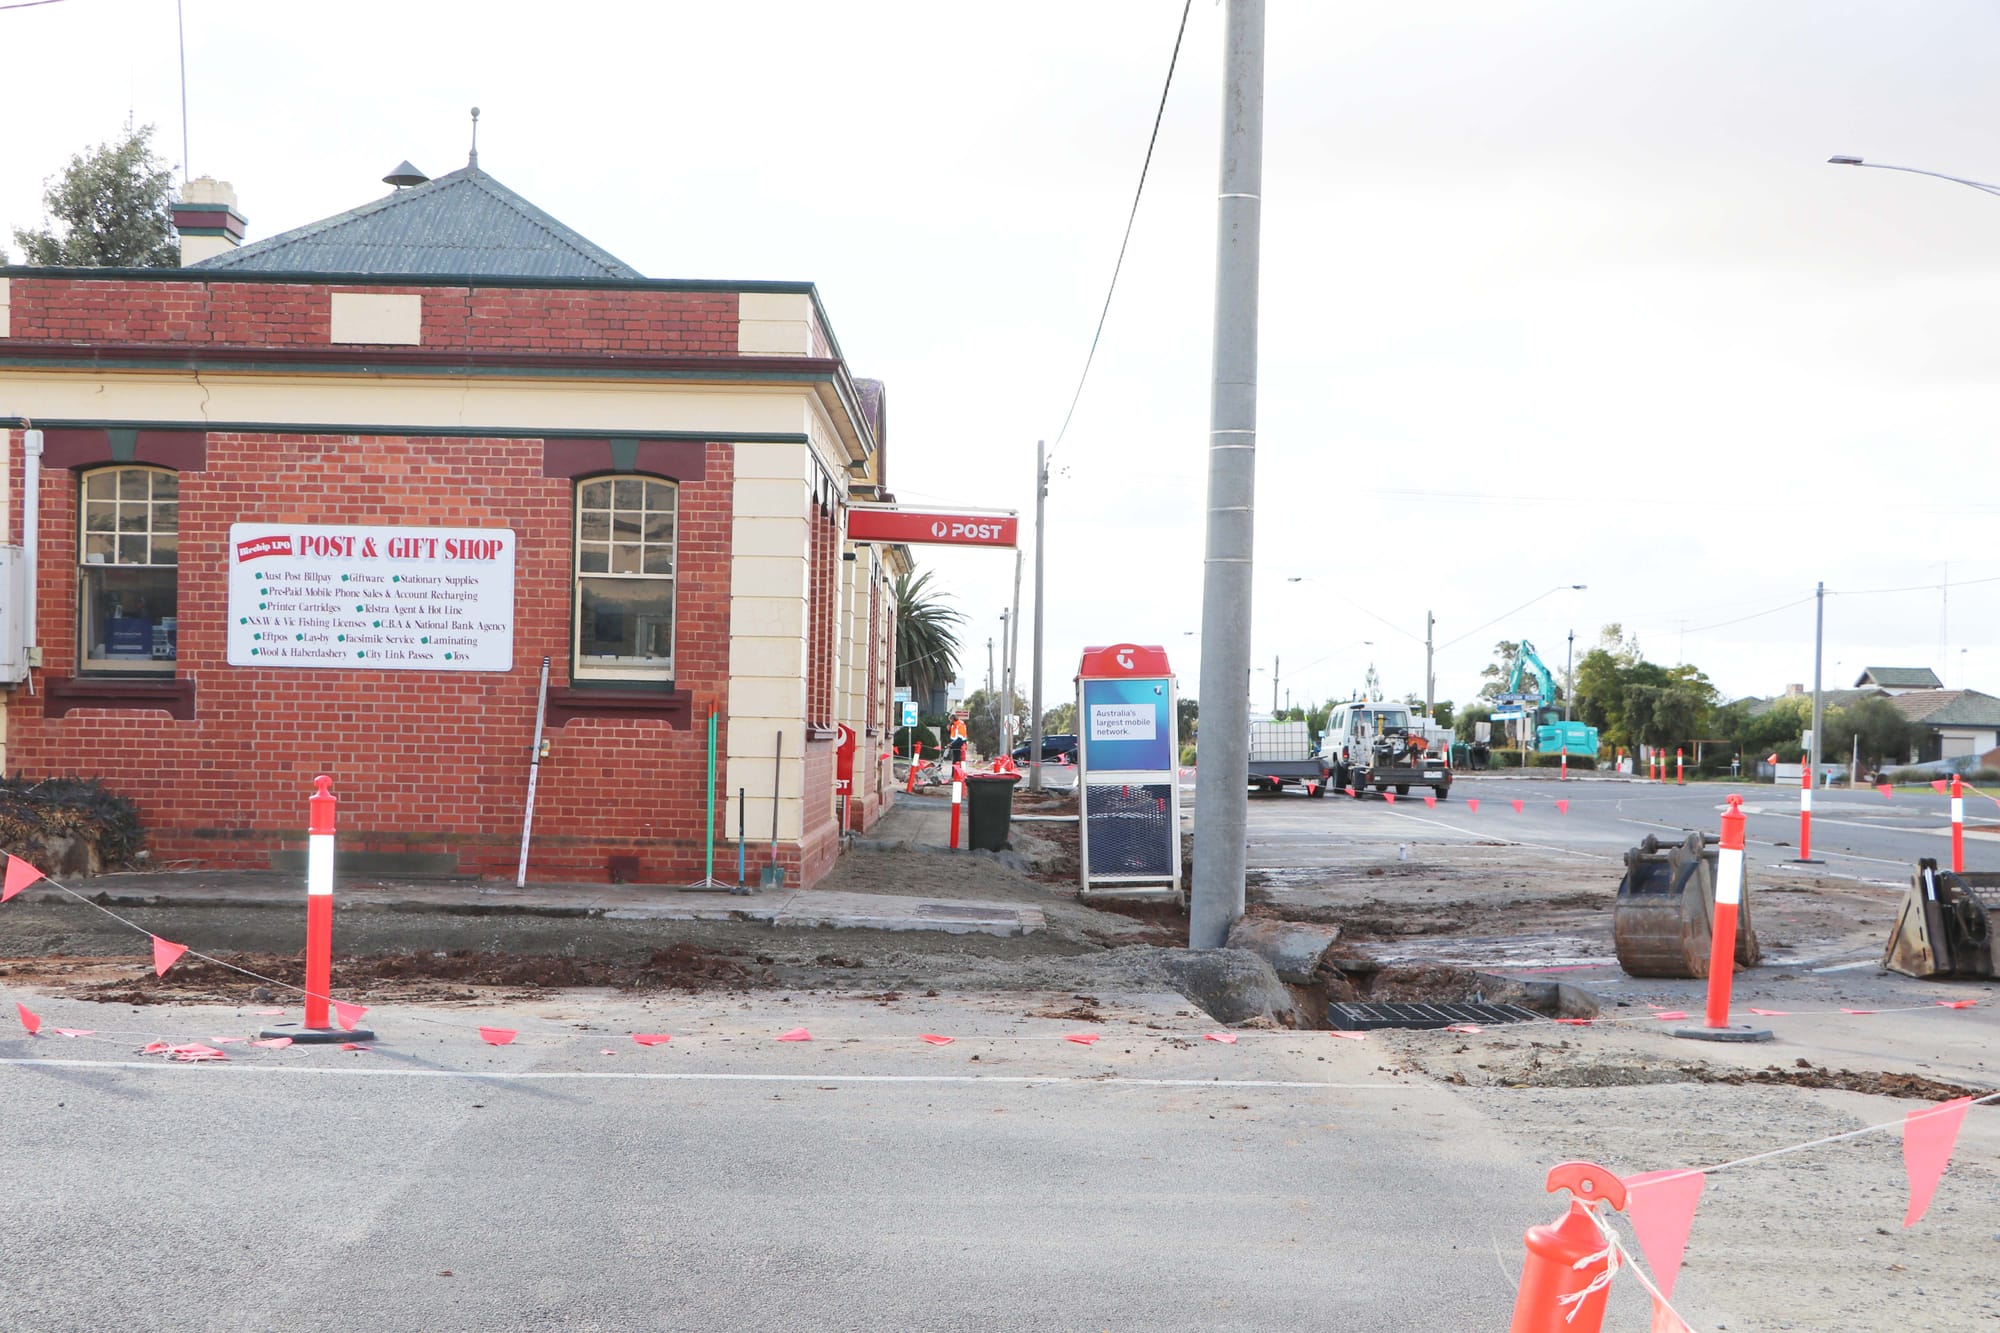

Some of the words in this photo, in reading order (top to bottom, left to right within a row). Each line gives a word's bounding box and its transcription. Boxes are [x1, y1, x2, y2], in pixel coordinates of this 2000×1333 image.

[952, 524, 1002, 539] POST
[272, 541, 290, 550] LPO
[300, 535, 356, 557] POST
[362, 537, 377, 557] &
[388, 537, 438, 559] GIFT
[445, 538, 503, 560] SHOP
[264, 571, 281, 580] Aust
[285, 571, 301, 581] Post
[304, 572, 331, 583] Billpay
[349, 573, 385, 583] Giftware
[400, 574, 442, 586] Stationary
[445, 575, 479, 586] Supplies
[269, 586, 302, 596] Pre-Paid
[305, 587, 332, 597] Mobile
[335, 588, 360, 597] Phone
[362, 588, 383, 598] Sales
[385, 589, 391, 598] &
[395, 589, 427, 599] Account
[431, 590, 478, 603] Recharging
[267, 601, 295, 611] Printer
[299, 603, 341, 614] Cartridges
[365, 604, 389, 613] Telstra
[394, 605, 416, 615] Agent
[419, 605, 424, 613] &
[428, 605, 441, 614] Hot
[445, 605, 463, 615] Line
[274, 616, 280, 625] &
[284, 617, 295, 625] Vic
[299, 617, 330, 628] Fishing
[333, 618, 367, 627] Licenses
[405, 620, 411, 629] &
[415, 620, 448, 629] National
[452, 620, 474, 630] Bank
[477, 621, 506, 632] Agency
[262, 631, 288, 643] Eftpos
[304, 632, 329, 644] Lay-by
[346, 633, 383, 643] Facsimile
[386, 634, 415, 644] Service
[429, 635, 478, 647] Laminating
[259, 647, 278, 656] Wool
[281, 648, 287, 657] &
[290, 648, 347, 659] Haberdashery
[366, 649, 381, 661] City
[385, 650, 405, 659] Link
[408, 650, 434, 660] Passes
[453, 651, 470, 662] Toys
[1096, 709, 1136, 717] Australia's
[1096, 719, 1123, 728] largest
[1125, 718, 1151, 726] mobile
